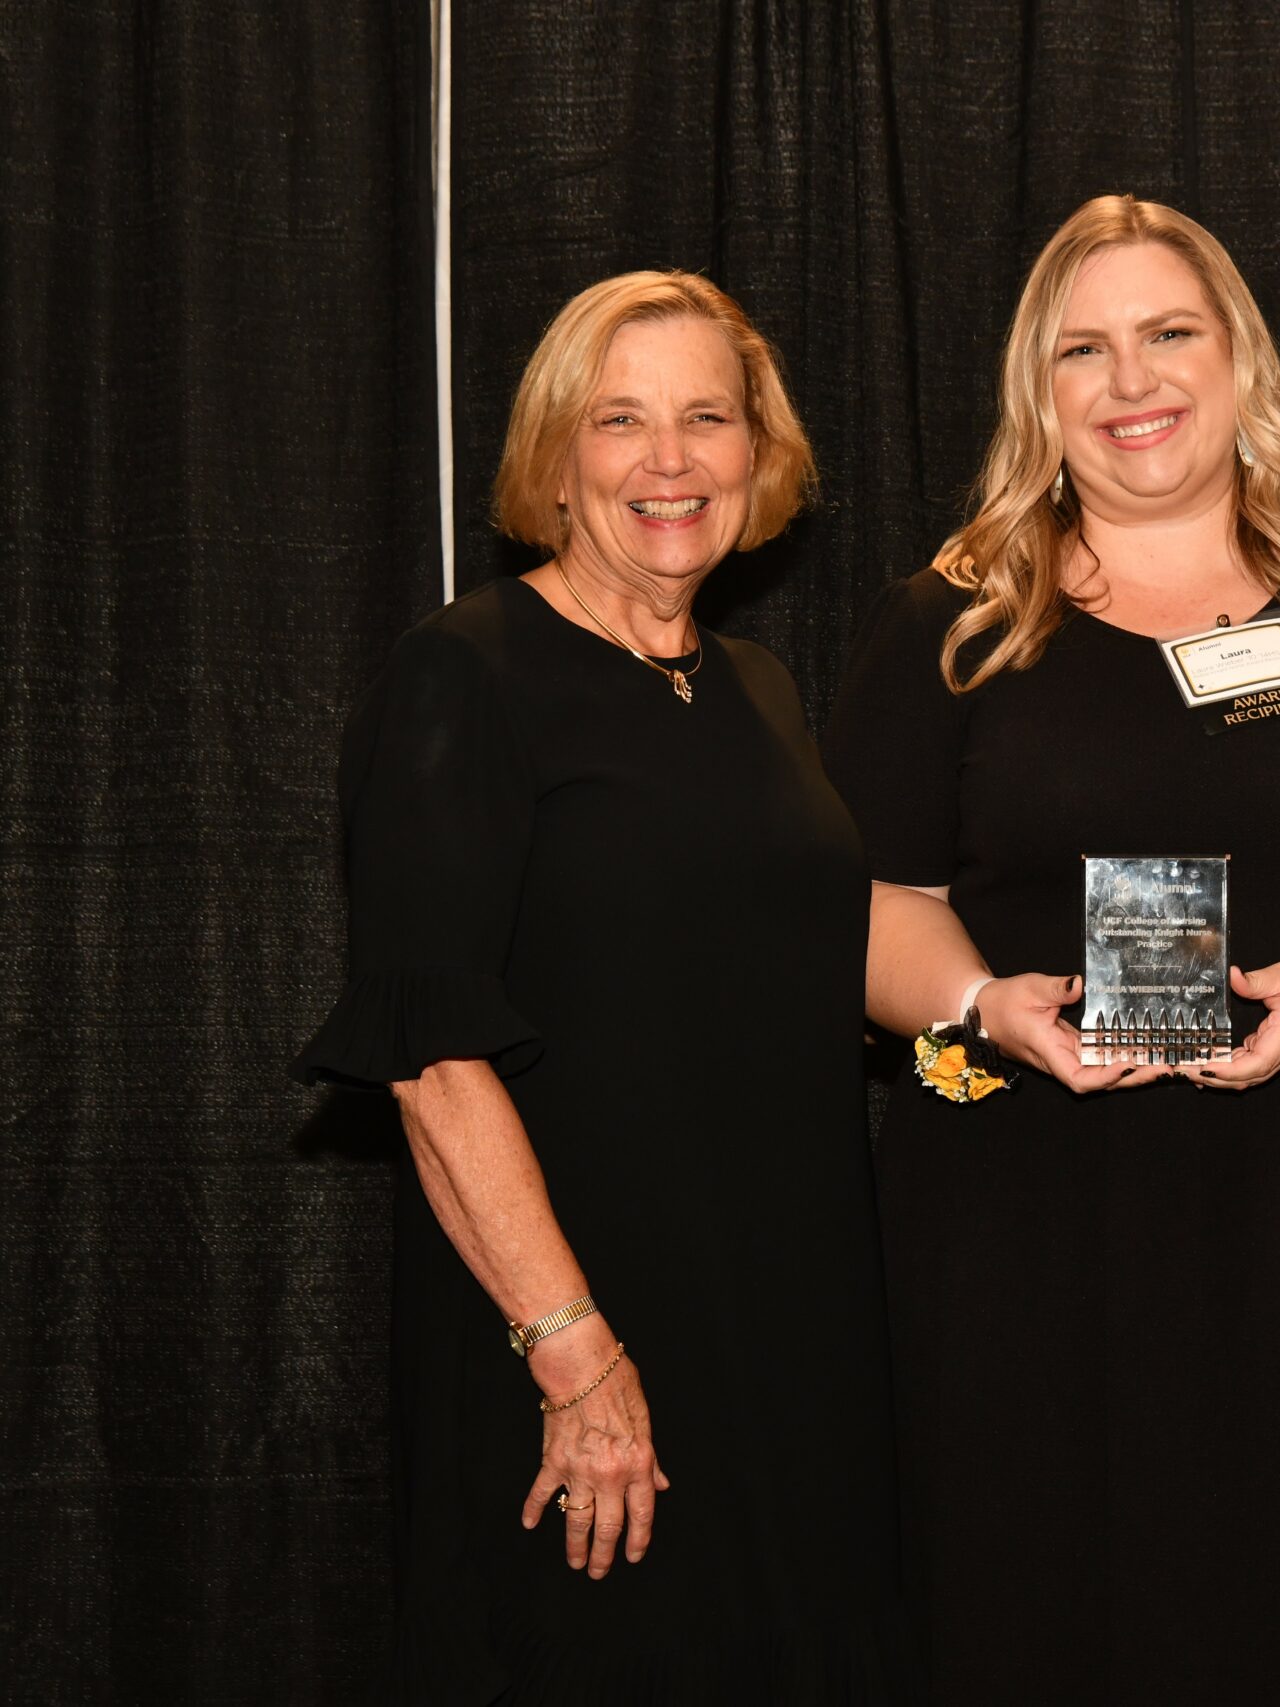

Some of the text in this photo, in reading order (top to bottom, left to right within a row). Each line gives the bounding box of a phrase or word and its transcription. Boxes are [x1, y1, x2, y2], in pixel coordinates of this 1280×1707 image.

[1220, 647, 1252, 660] Laura
[1103, 917, 1207, 927] UCF College of Nursing
[1098, 928, 1213, 938] Outstanding Knight Nurse
[1137, 941, 1173, 949] Practice
[1128, 985, 1166, 994] WIEBER
